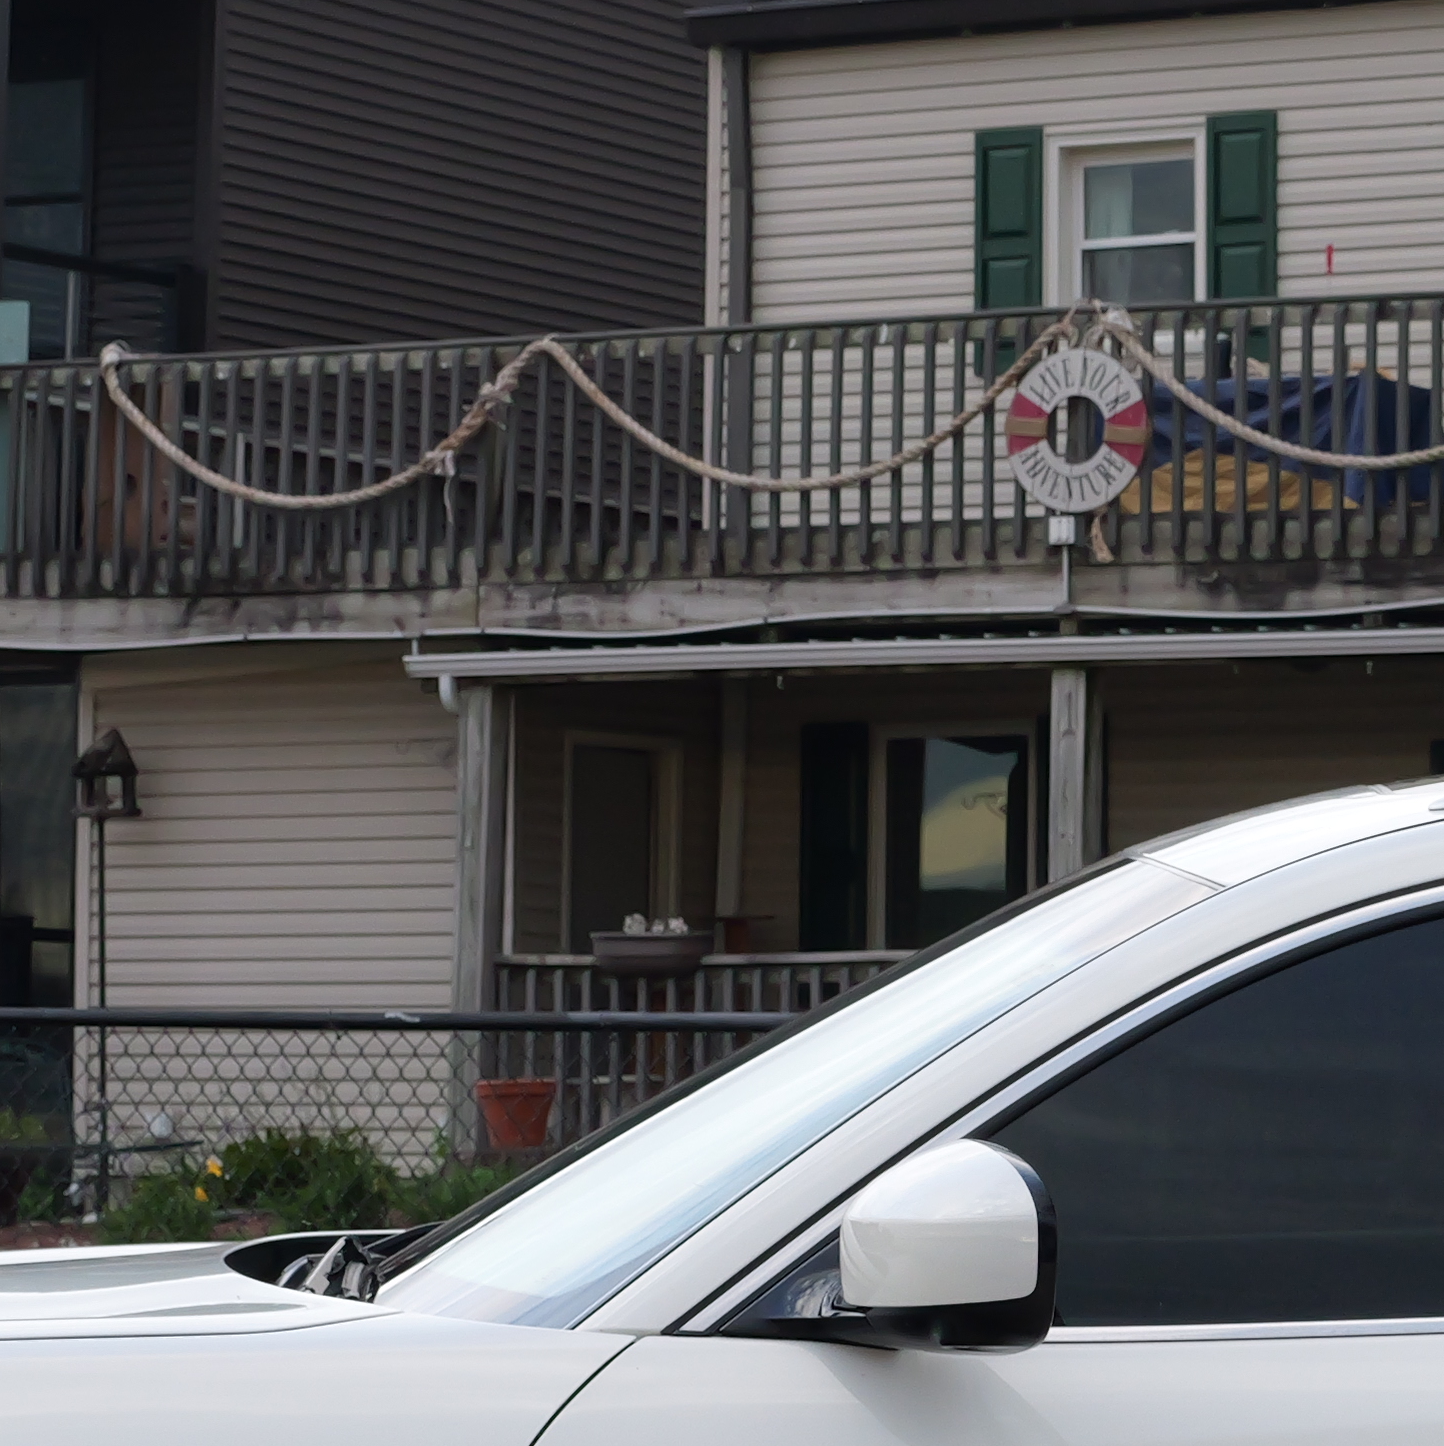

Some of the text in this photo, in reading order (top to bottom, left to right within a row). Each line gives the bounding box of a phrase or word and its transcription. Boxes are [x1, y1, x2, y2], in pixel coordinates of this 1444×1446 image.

[1029, 355, 1131, 413] LIVE YOUR
[1019, 448, 1126, 502] ADVENTURE
